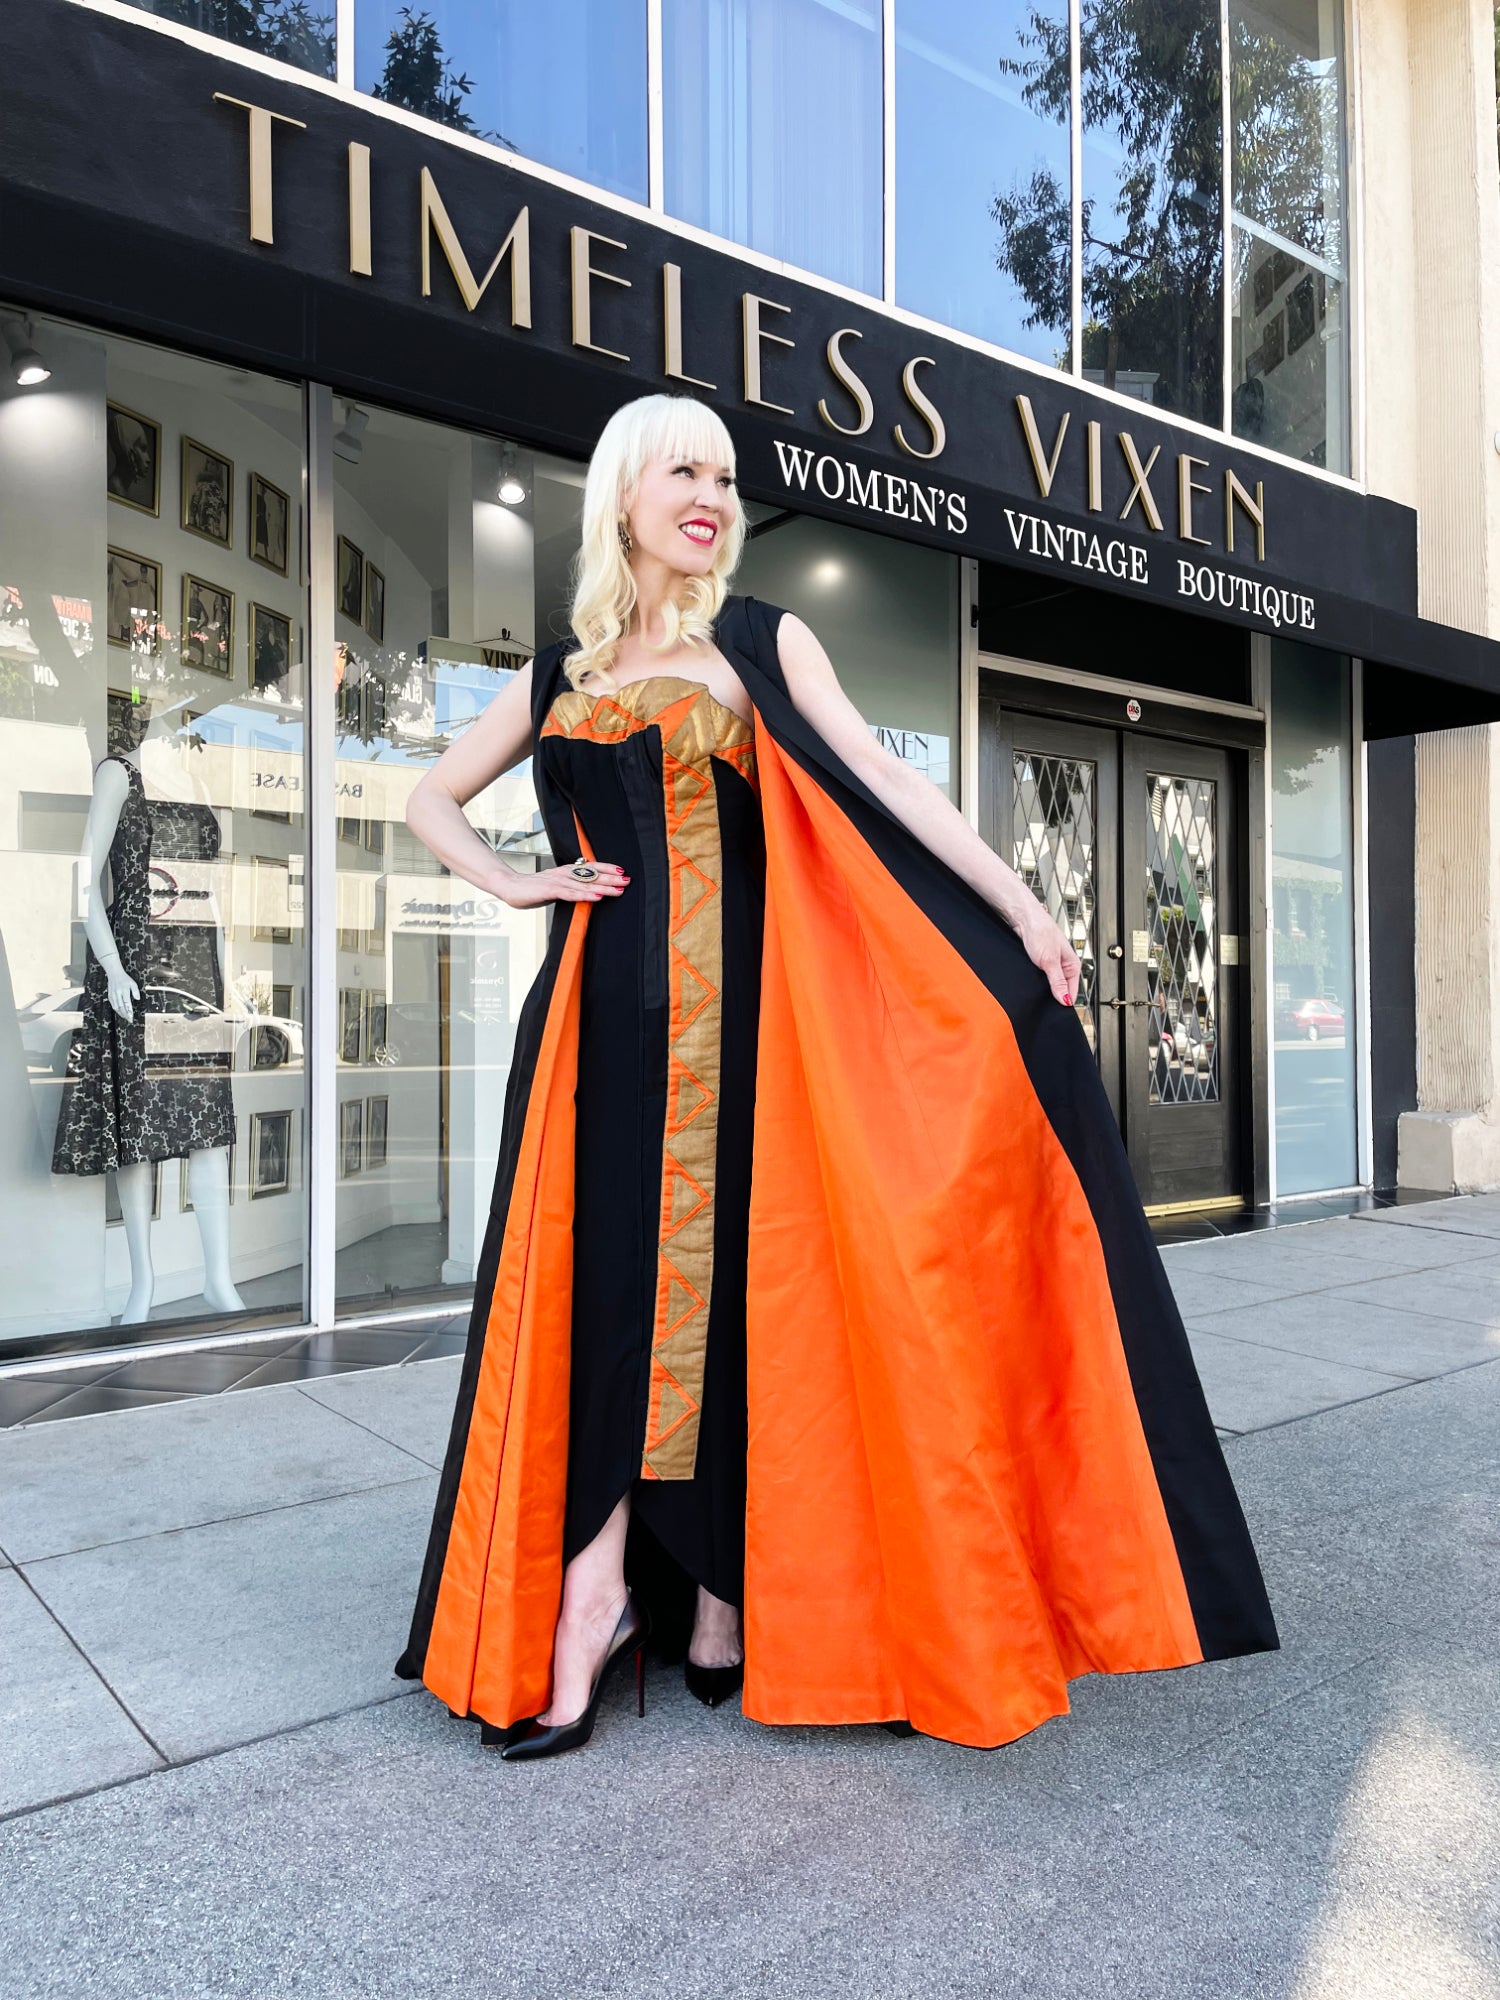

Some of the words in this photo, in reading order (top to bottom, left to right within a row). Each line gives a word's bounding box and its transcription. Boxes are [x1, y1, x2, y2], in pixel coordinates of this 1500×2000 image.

[212, 92, 946, 459] TIMELESS
[1016, 395, 1265, 562] VIXEN
[774, 440, 968, 534] WOMEN'S
[1004, 509, 1149, 584] VINTAGE
[1177, 560, 1316, 630] BOUTIQUE
